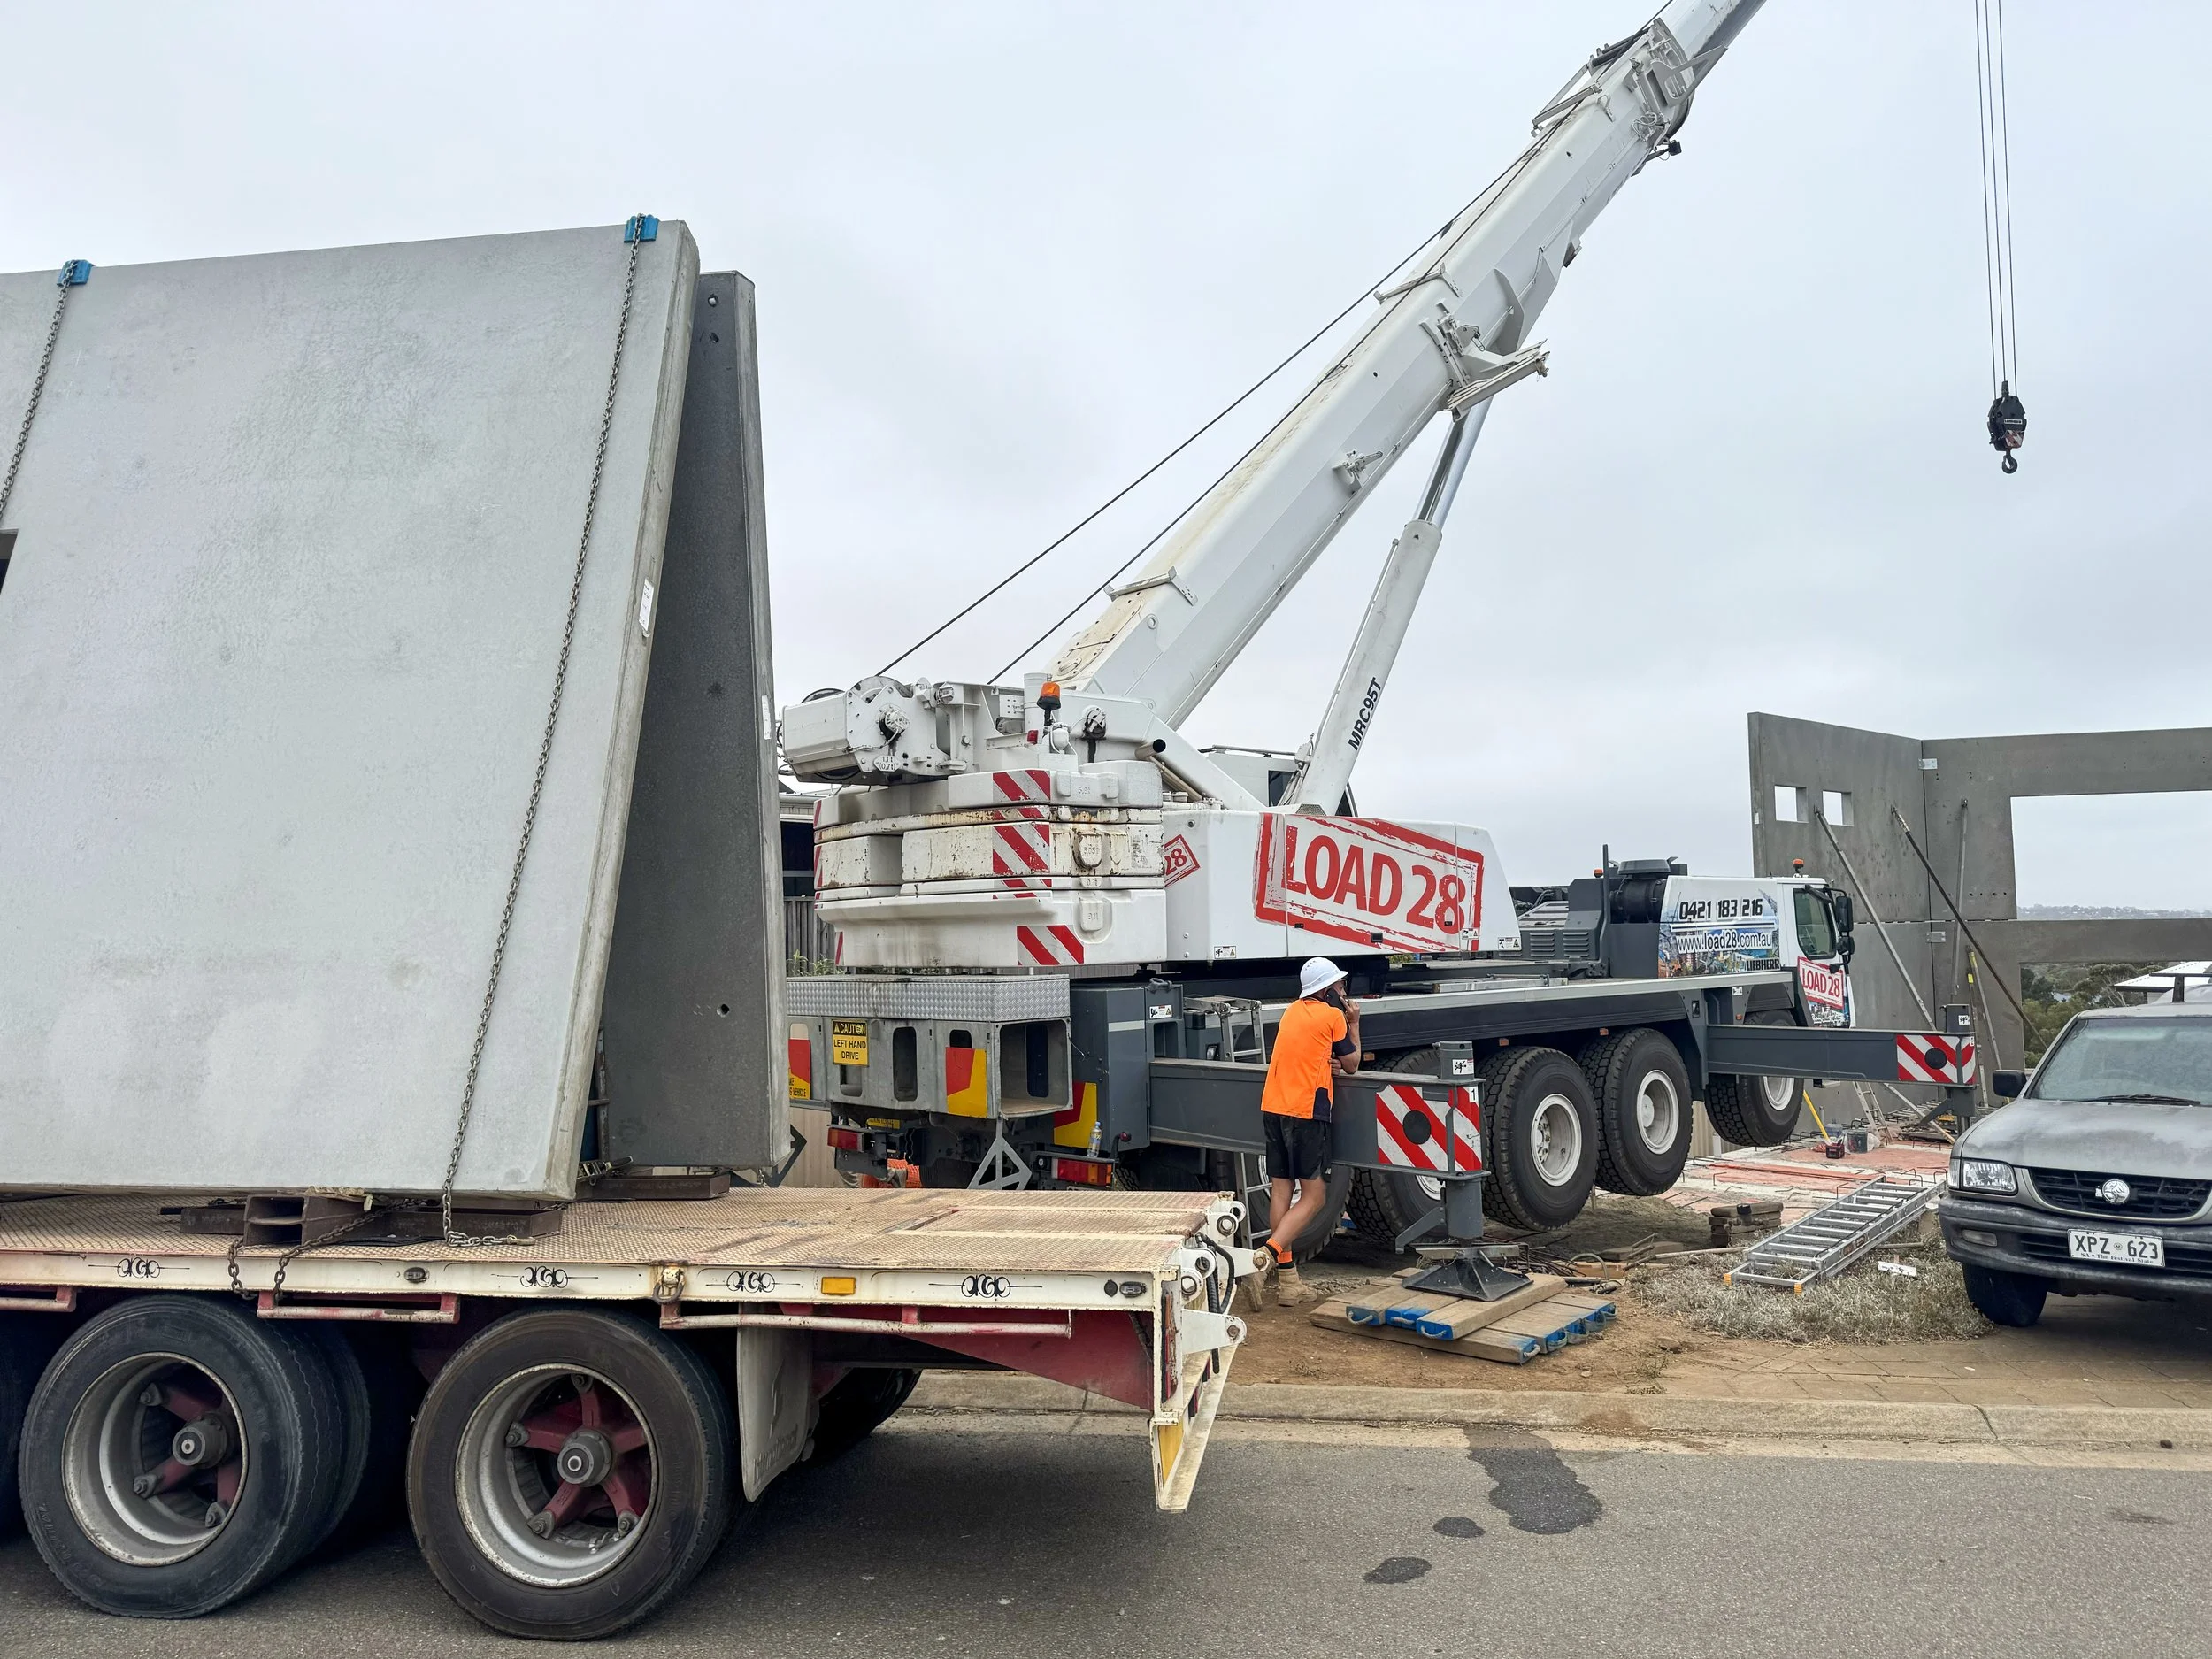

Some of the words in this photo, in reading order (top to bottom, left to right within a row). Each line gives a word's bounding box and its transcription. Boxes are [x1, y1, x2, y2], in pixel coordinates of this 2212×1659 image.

[1348, 677, 1381, 750] MRC95T
[1164, 848, 1187, 876] 28
[1281, 825, 1402, 916] LOAD
[1406, 864, 1466, 934] 28
[1679, 901, 1711, 920] 0421
[1717, 899, 1738, 918] 183
[1742, 898, 1763, 916] 216
[1677, 931, 1771, 951] www.load28.com.au
[1746, 959, 1780, 972] LIEBHERR
[1801, 968, 1826, 993] LOAD
[1828, 976, 1840, 997] 28
[840, 1024, 865, 1034] CAUTION
[833, 1039, 848, 1048] LEFT
[849, 1041, 866, 1049] HAND
[841, 1051, 859, 1060] DRIVE
[1471, 1088, 1475, 1100] 1
[2074, 1235, 2110, 1255] XPZ
[2127, 1240, 2158, 1259] 623
